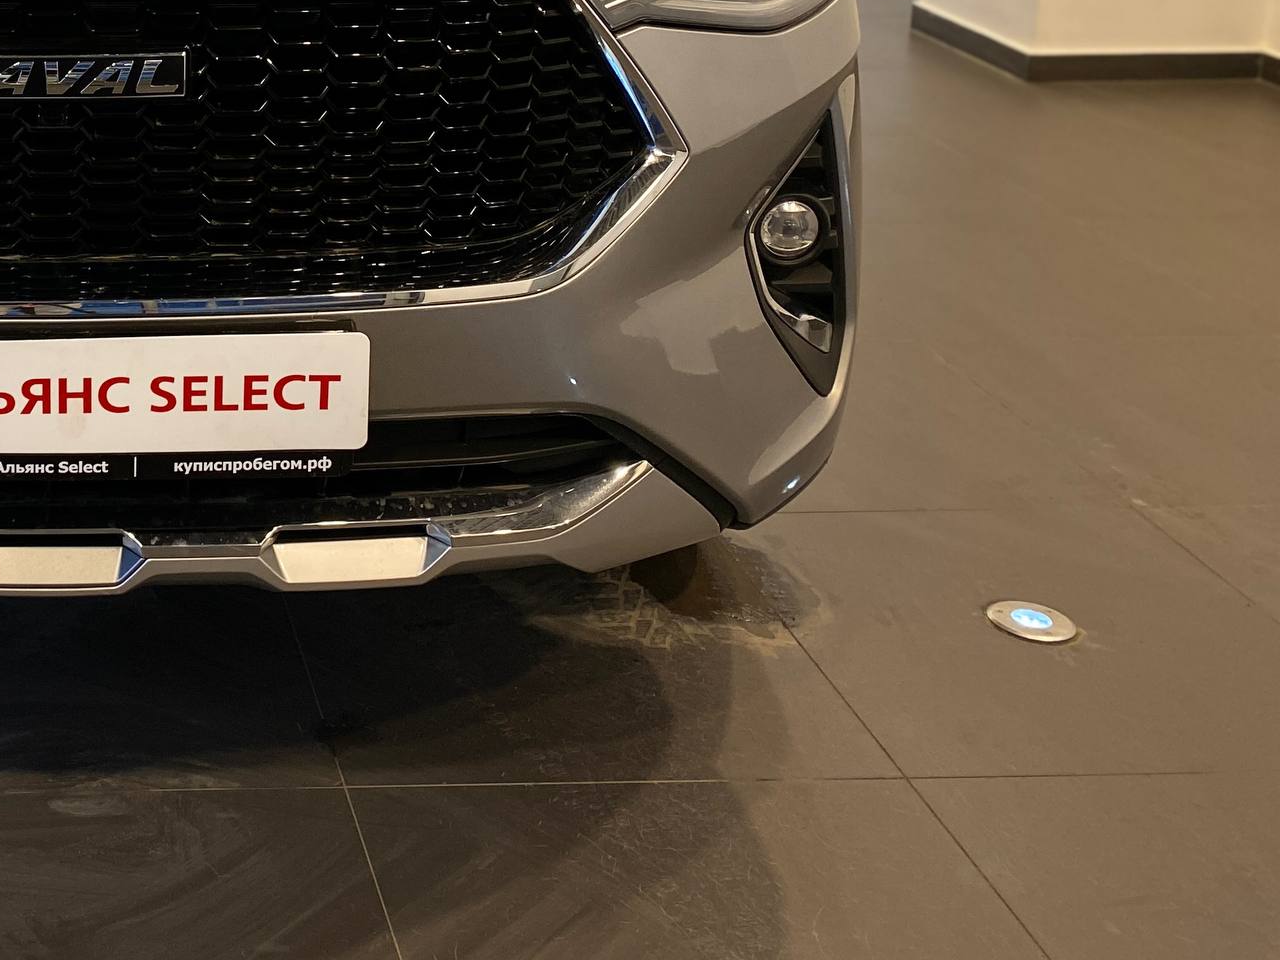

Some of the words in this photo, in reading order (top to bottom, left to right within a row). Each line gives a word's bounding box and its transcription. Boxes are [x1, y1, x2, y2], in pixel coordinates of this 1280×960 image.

[150, 374, 341, 412] SELECT
[58, 459, 109, 474] Select
[173, 456, 333, 475] куписпробегом.рф
